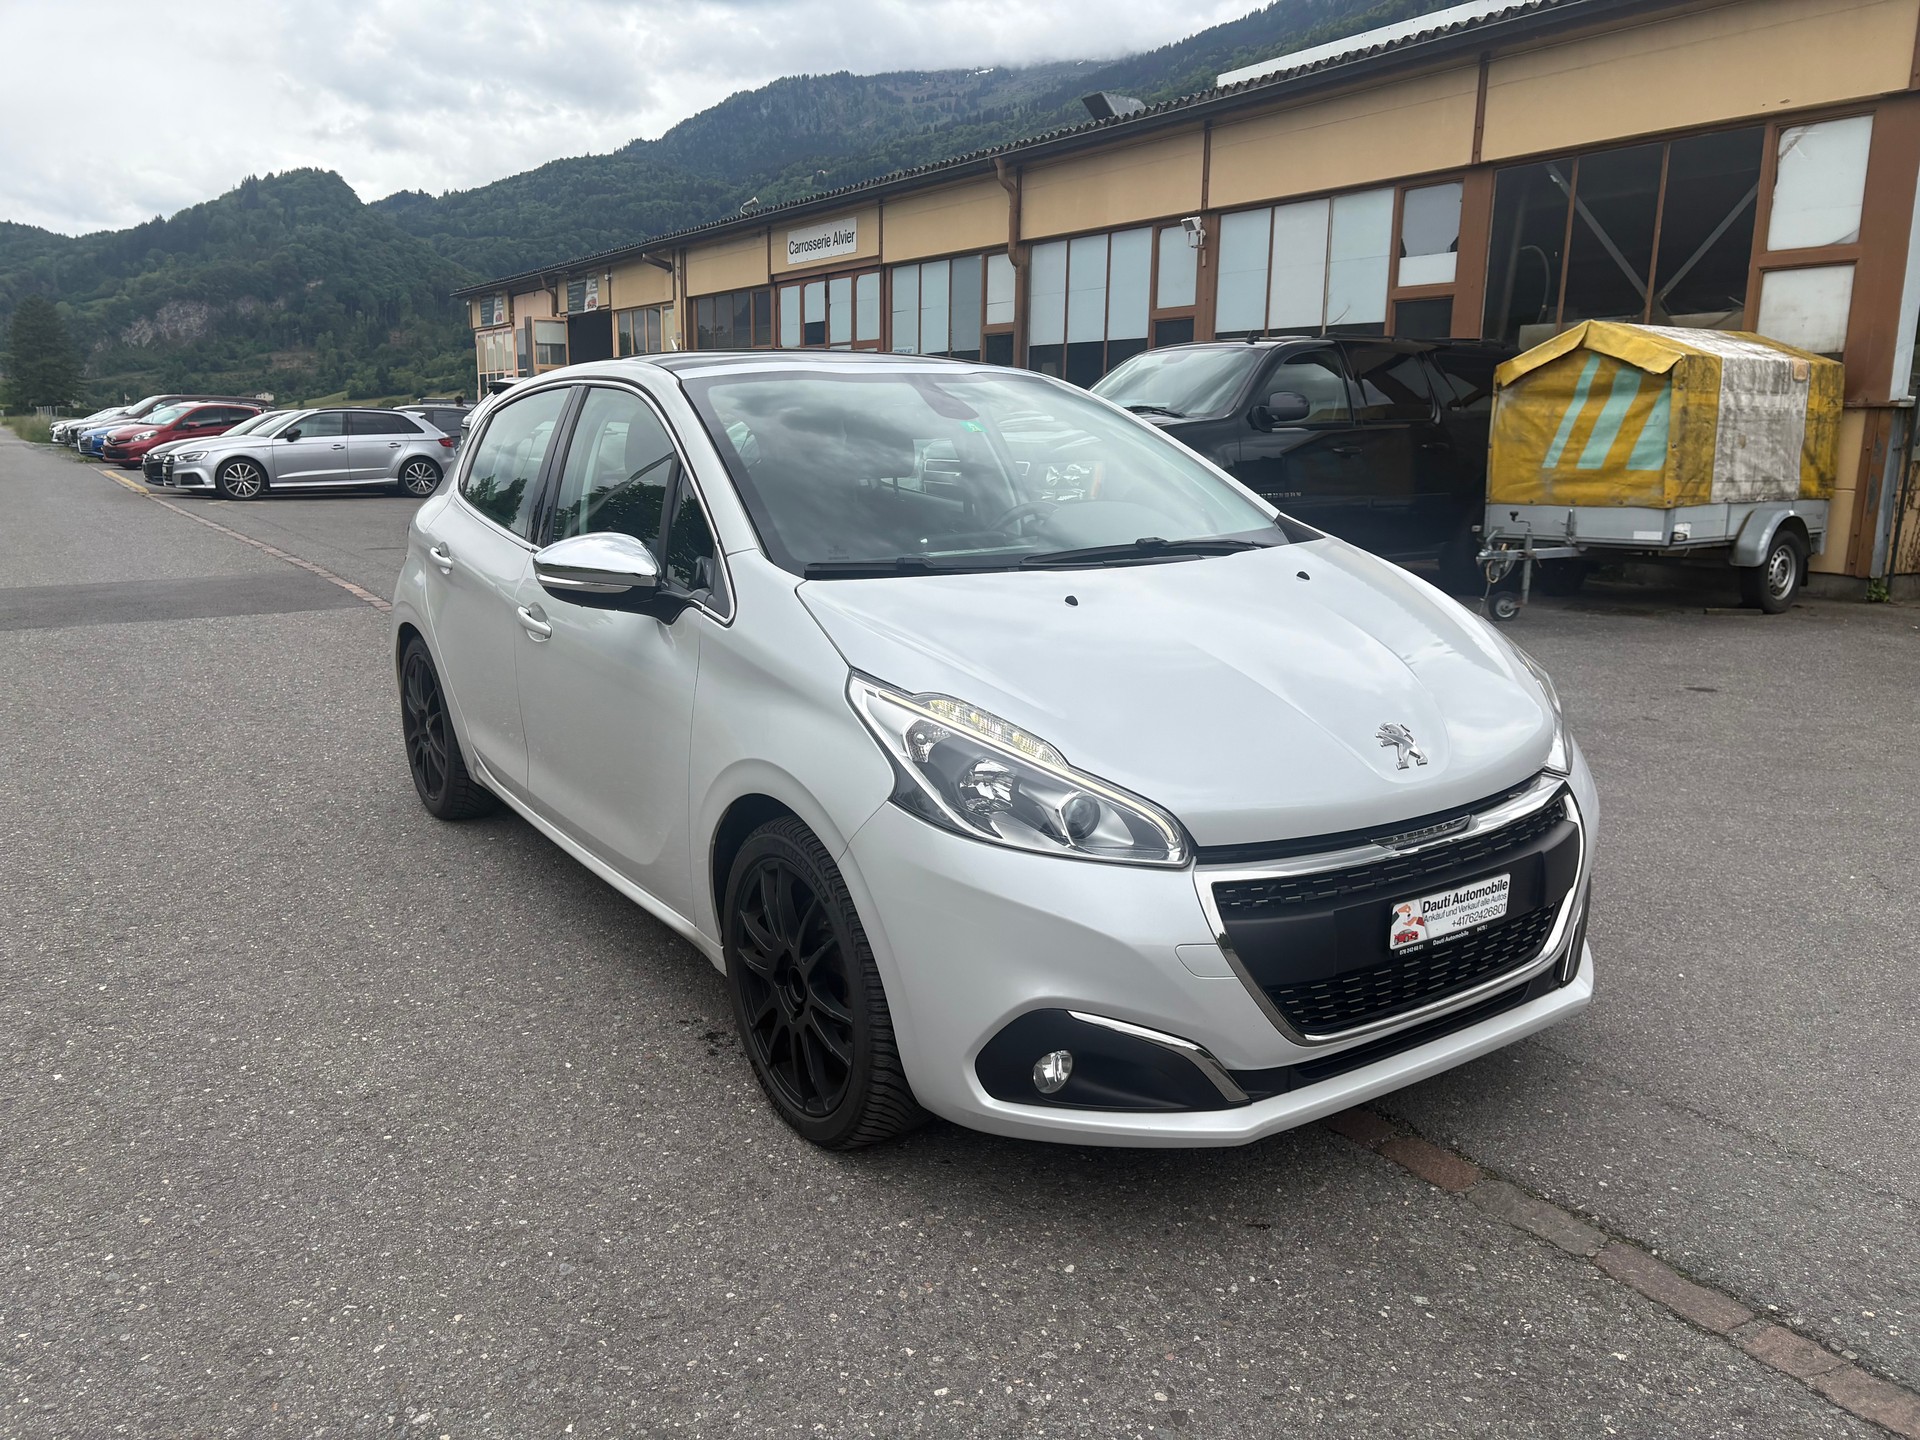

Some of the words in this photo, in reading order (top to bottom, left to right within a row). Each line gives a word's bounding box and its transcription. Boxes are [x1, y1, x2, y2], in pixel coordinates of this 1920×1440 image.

[789, 234, 831, 254] Carrosserie
[833, 229, 855, 246] Alvier
[1422, 896, 1451, 913] Dauti
[1451, 879, 1508, 906] Automobile
[1424, 908, 1446, 922] Ankauf
[1446, 905, 1457, 917] und
[1458, 900, 1480, 916] Verkauf
[1490, 893, 1507, 904] Autos
